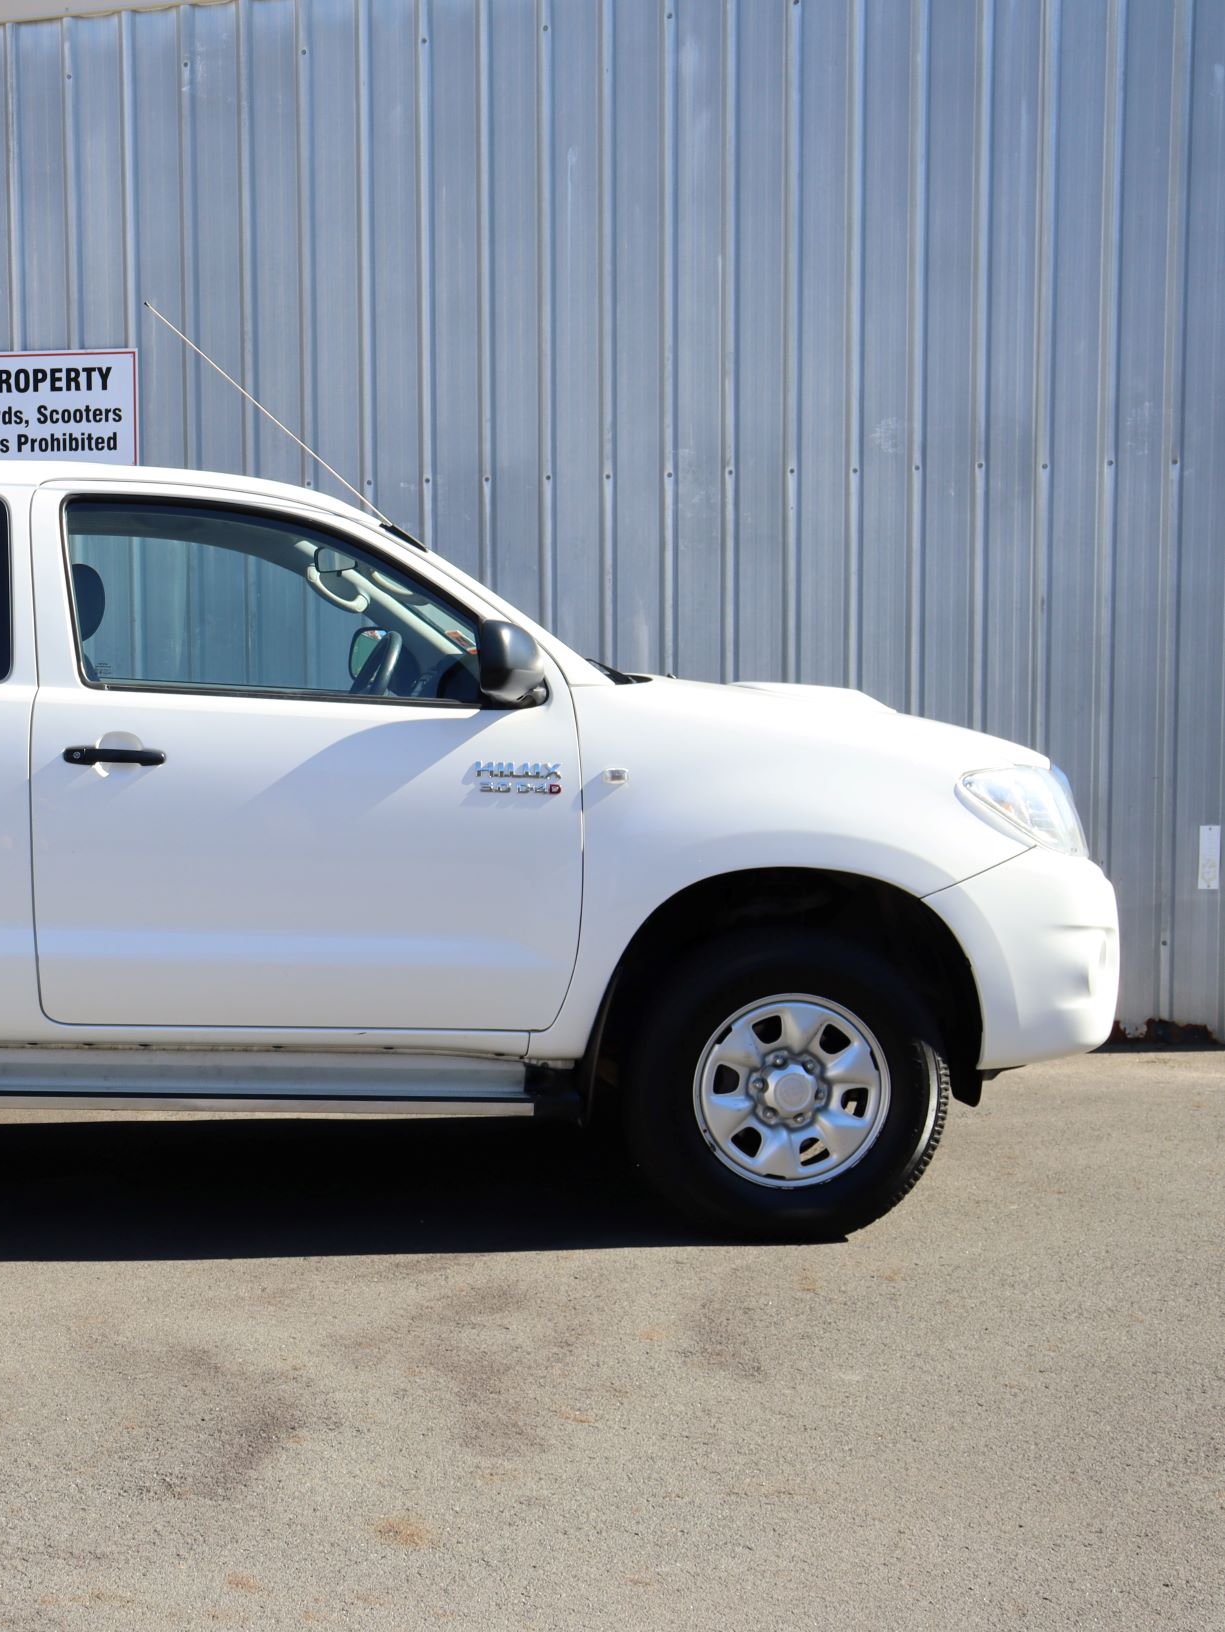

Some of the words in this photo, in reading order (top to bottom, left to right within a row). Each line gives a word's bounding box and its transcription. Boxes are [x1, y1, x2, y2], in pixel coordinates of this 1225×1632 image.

[36, 404, 123, 425] Scooters
[16, 431, 118, 454] Prohibited
[474, 760, 562, 780] HILUX
